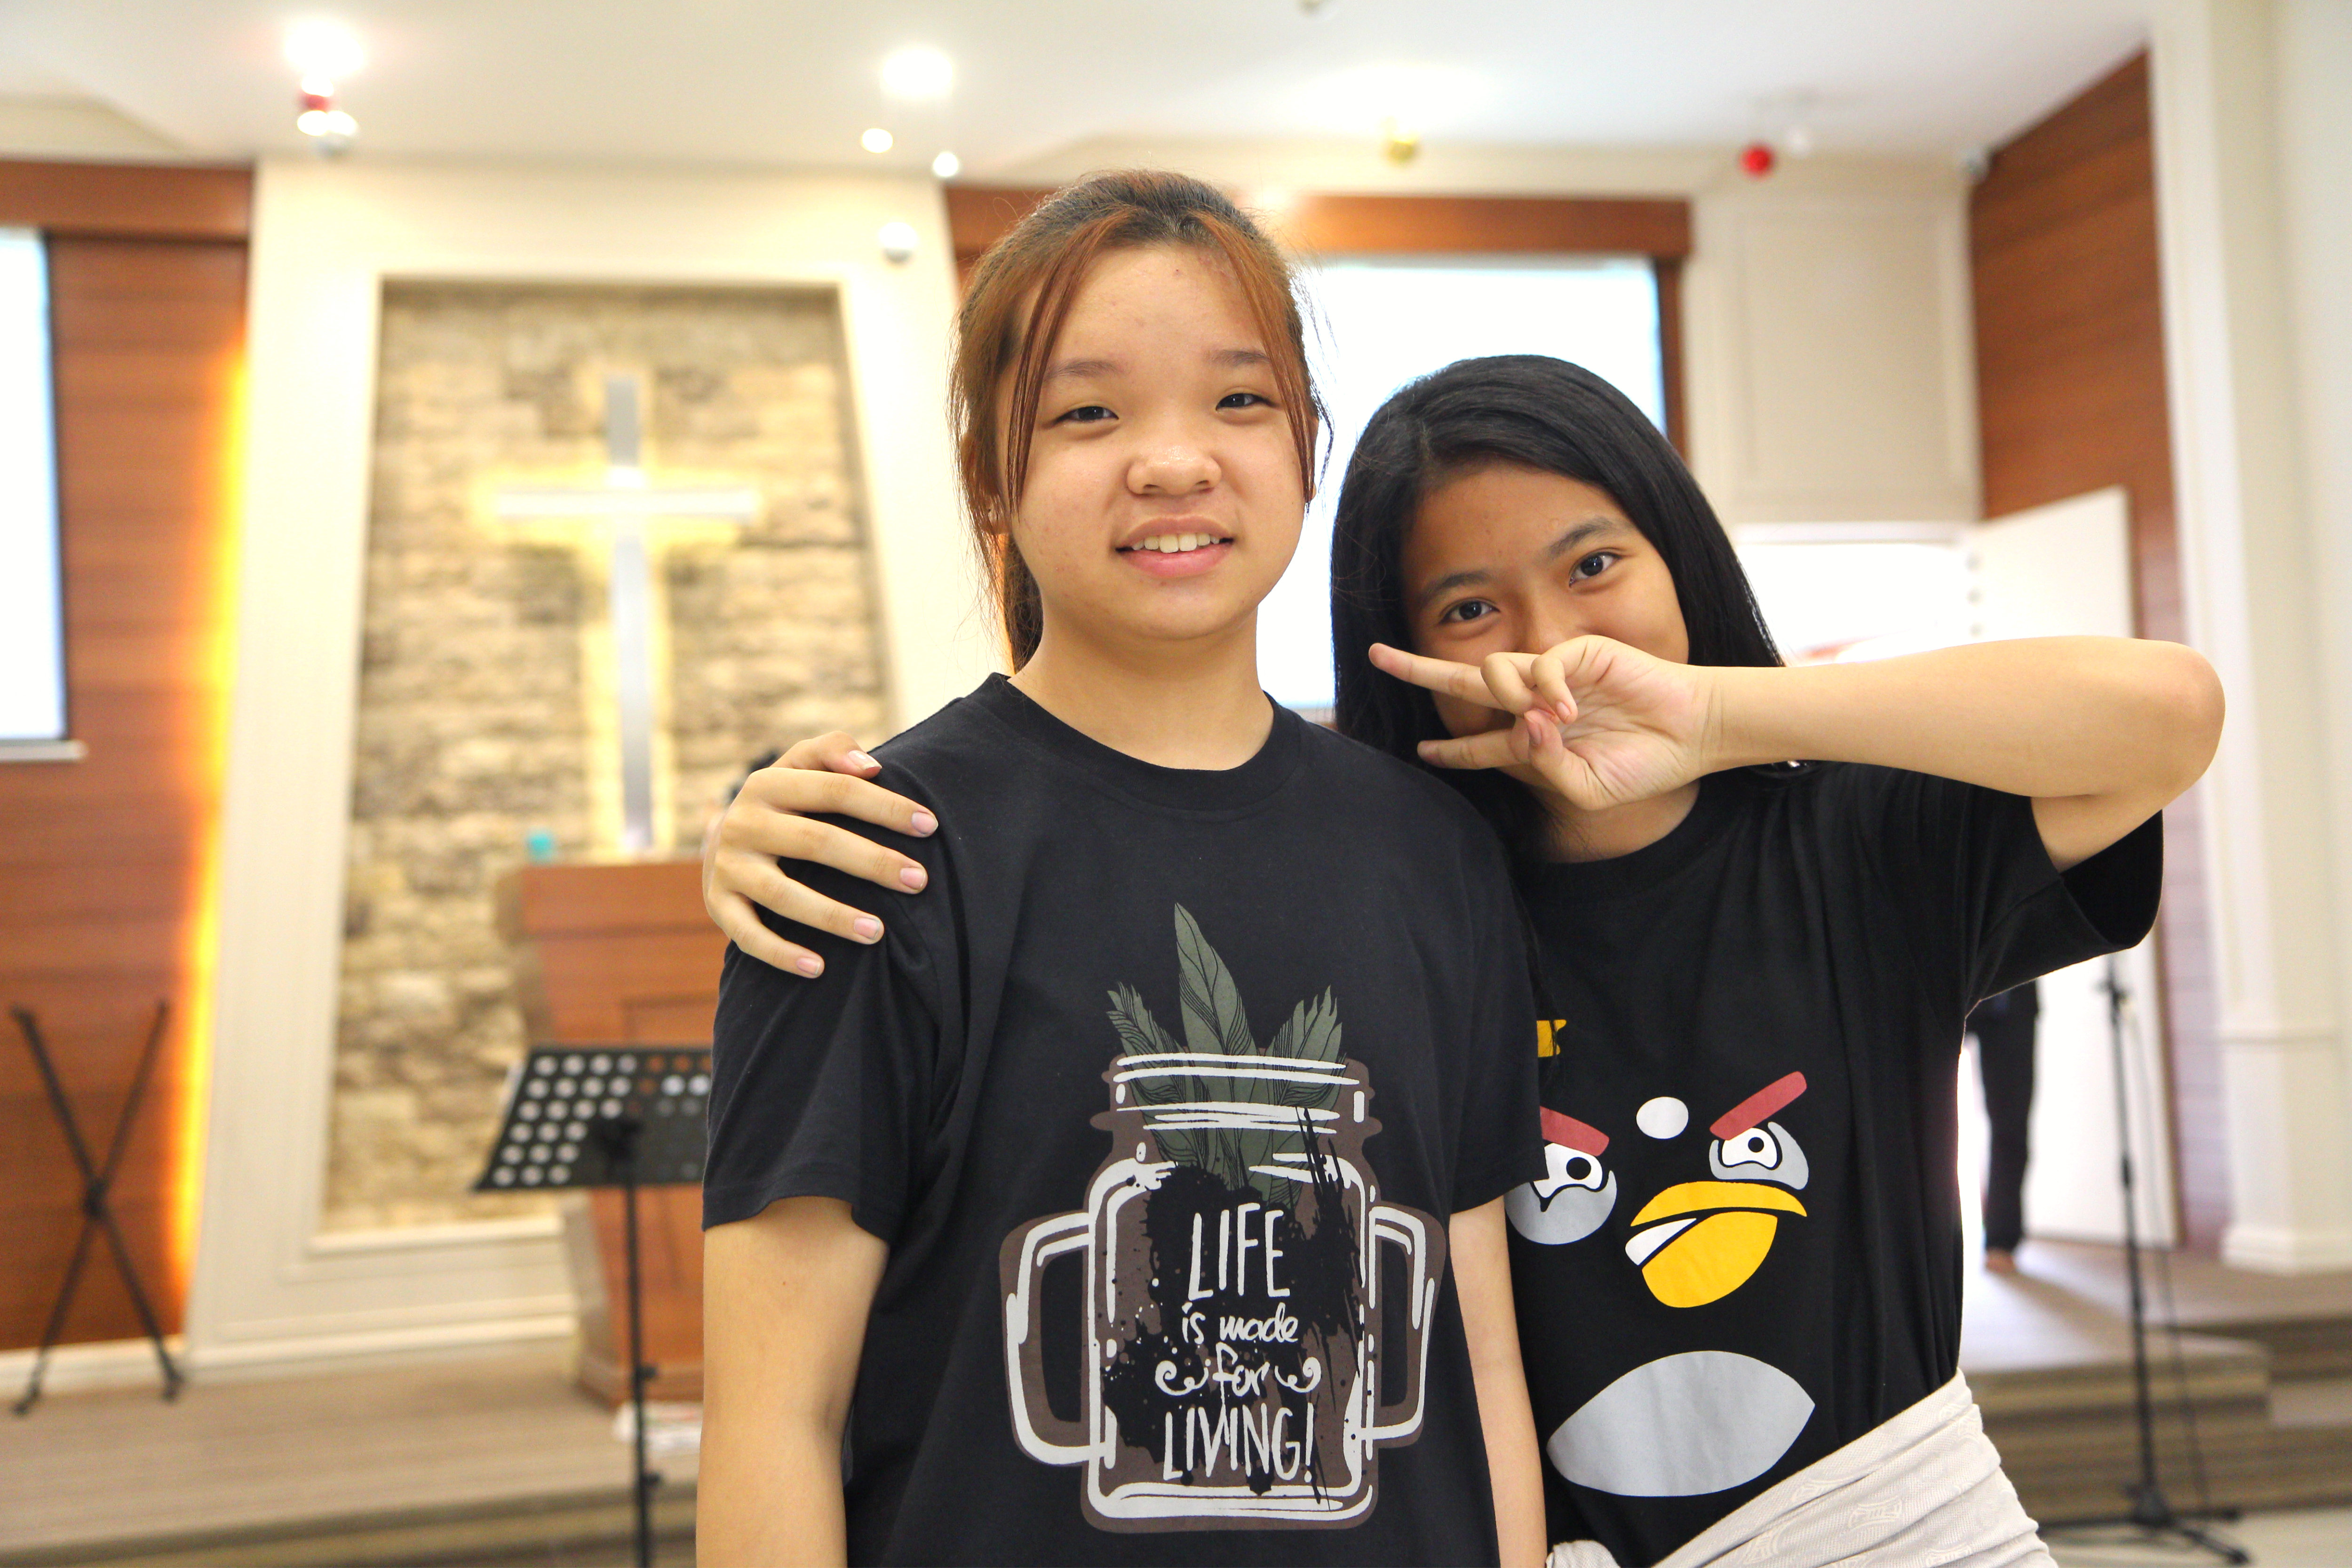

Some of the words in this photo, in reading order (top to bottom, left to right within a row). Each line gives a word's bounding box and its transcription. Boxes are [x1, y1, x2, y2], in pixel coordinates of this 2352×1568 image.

[1189, 1203, 1290, 1300] LIFE
[1181, 1301, 1205, 1344] is
[1219, 1302, 1298, 1342] made
[1212, 1342, 1270, 1446] for
[1163, 1402, 1314, 1482] LIVING!
